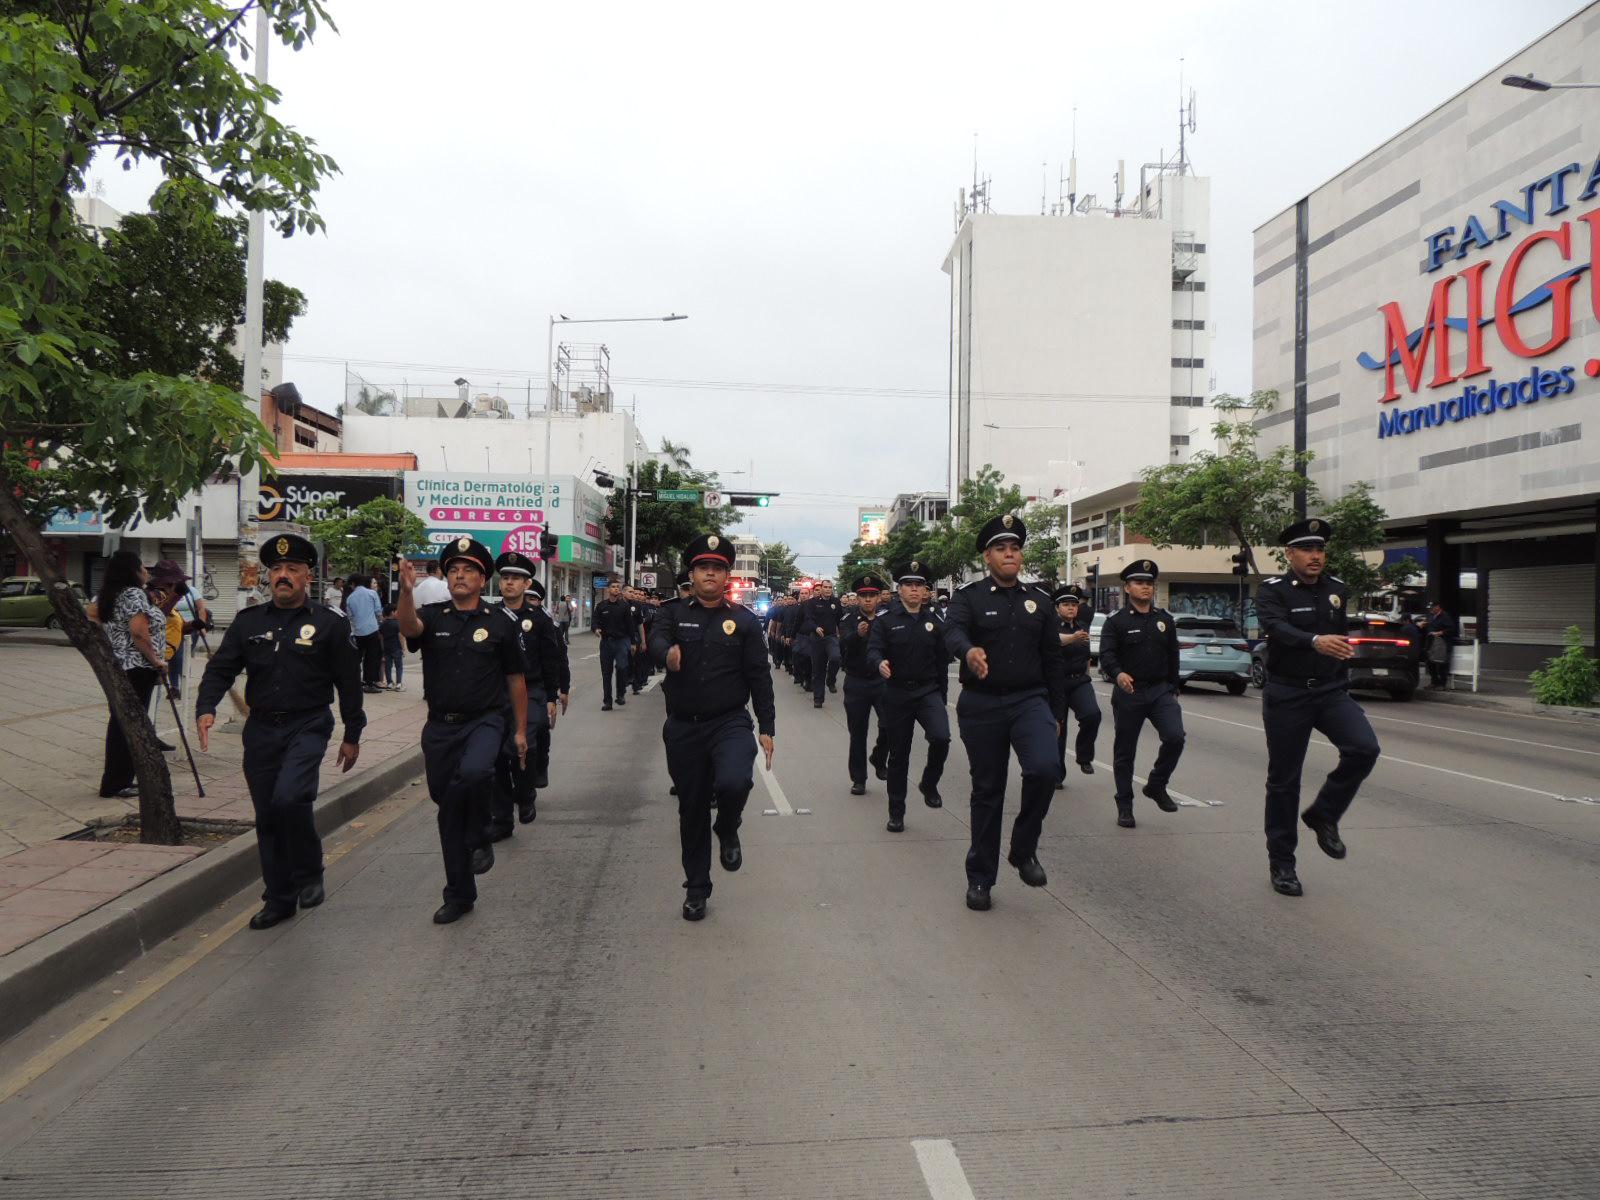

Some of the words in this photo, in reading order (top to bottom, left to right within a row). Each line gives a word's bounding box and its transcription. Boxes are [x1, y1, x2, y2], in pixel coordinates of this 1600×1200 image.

[1378, 366, 1575, 439] Manualidades
[417, 479, 460, 492] Clínica
[286, 485, 346, 507] Súper
[417, 494, 425, 507] y
[430, 494, 492, 507] Medicina
[496, 496, 560, 508] Antiedd
